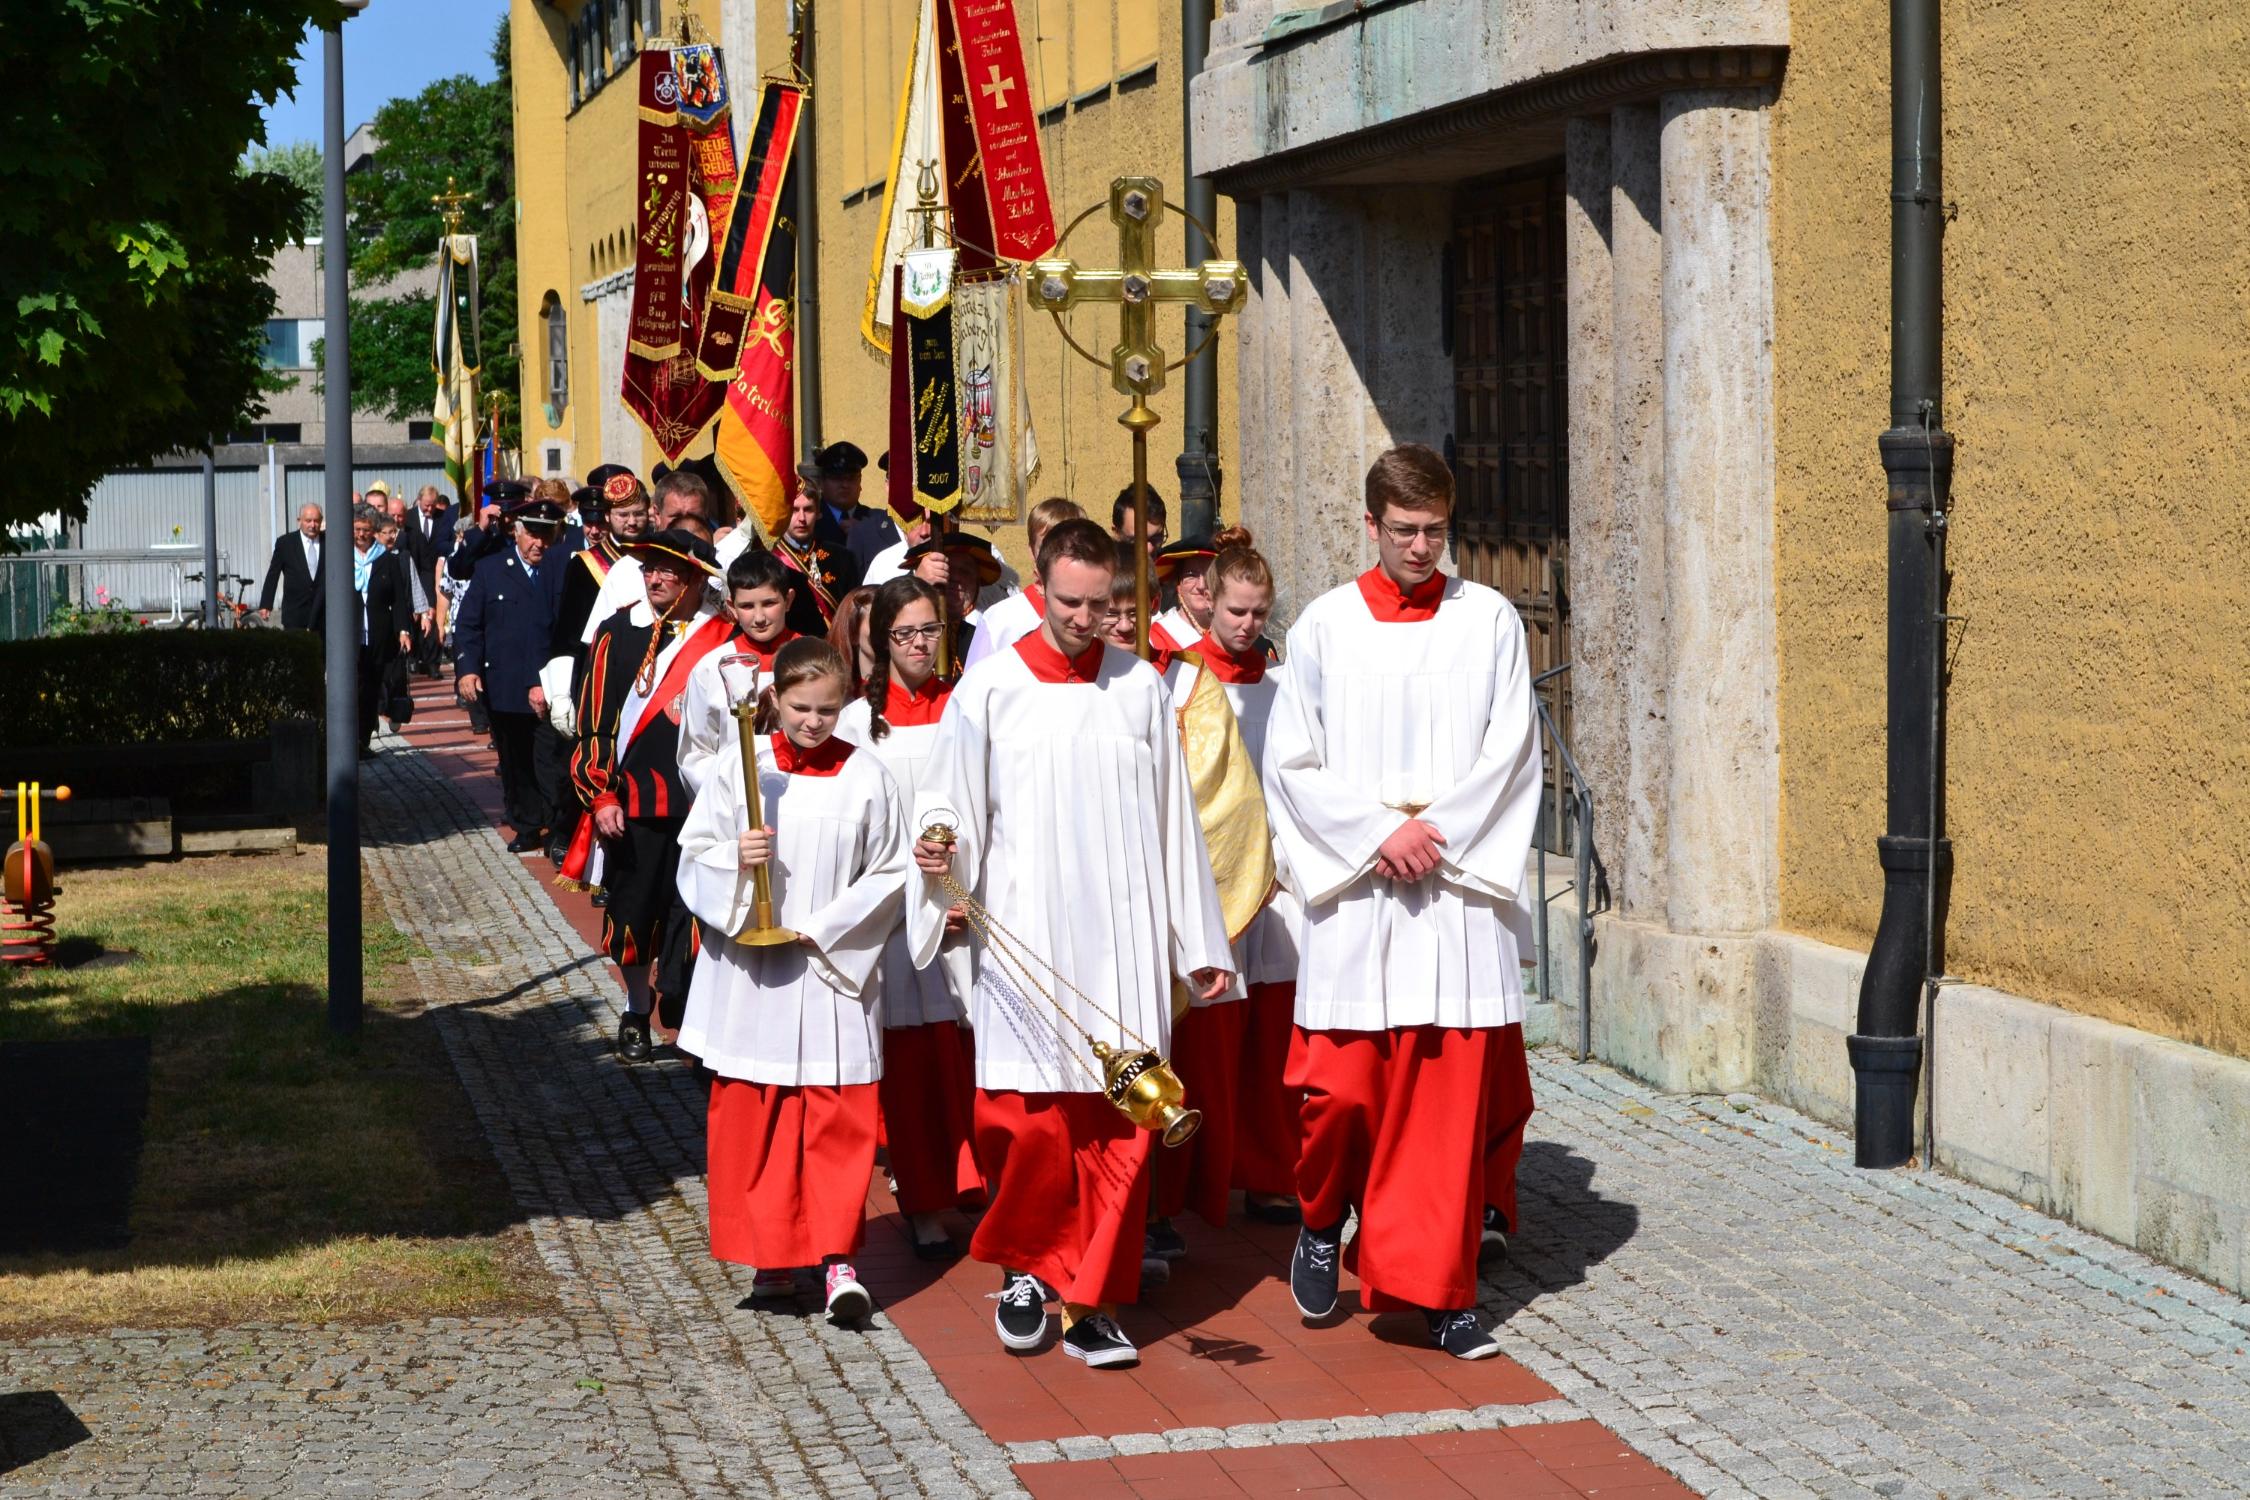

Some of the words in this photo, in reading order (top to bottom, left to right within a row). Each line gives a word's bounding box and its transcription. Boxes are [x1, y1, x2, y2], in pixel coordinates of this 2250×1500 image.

[981, 18, 992, 28] der
[980, 43, 1003, 58] Fahne
[661, 133, 674, 144] In
[692, 136, 730, 153] TREUE
[1005, 149, 1018, 161] und
[699, 159, 733, 177] TREUE
[1002, 181, 1036, 202] Markus
[648, 305, 667, 321] Bug
[928, 472, 950, 484] 2007
